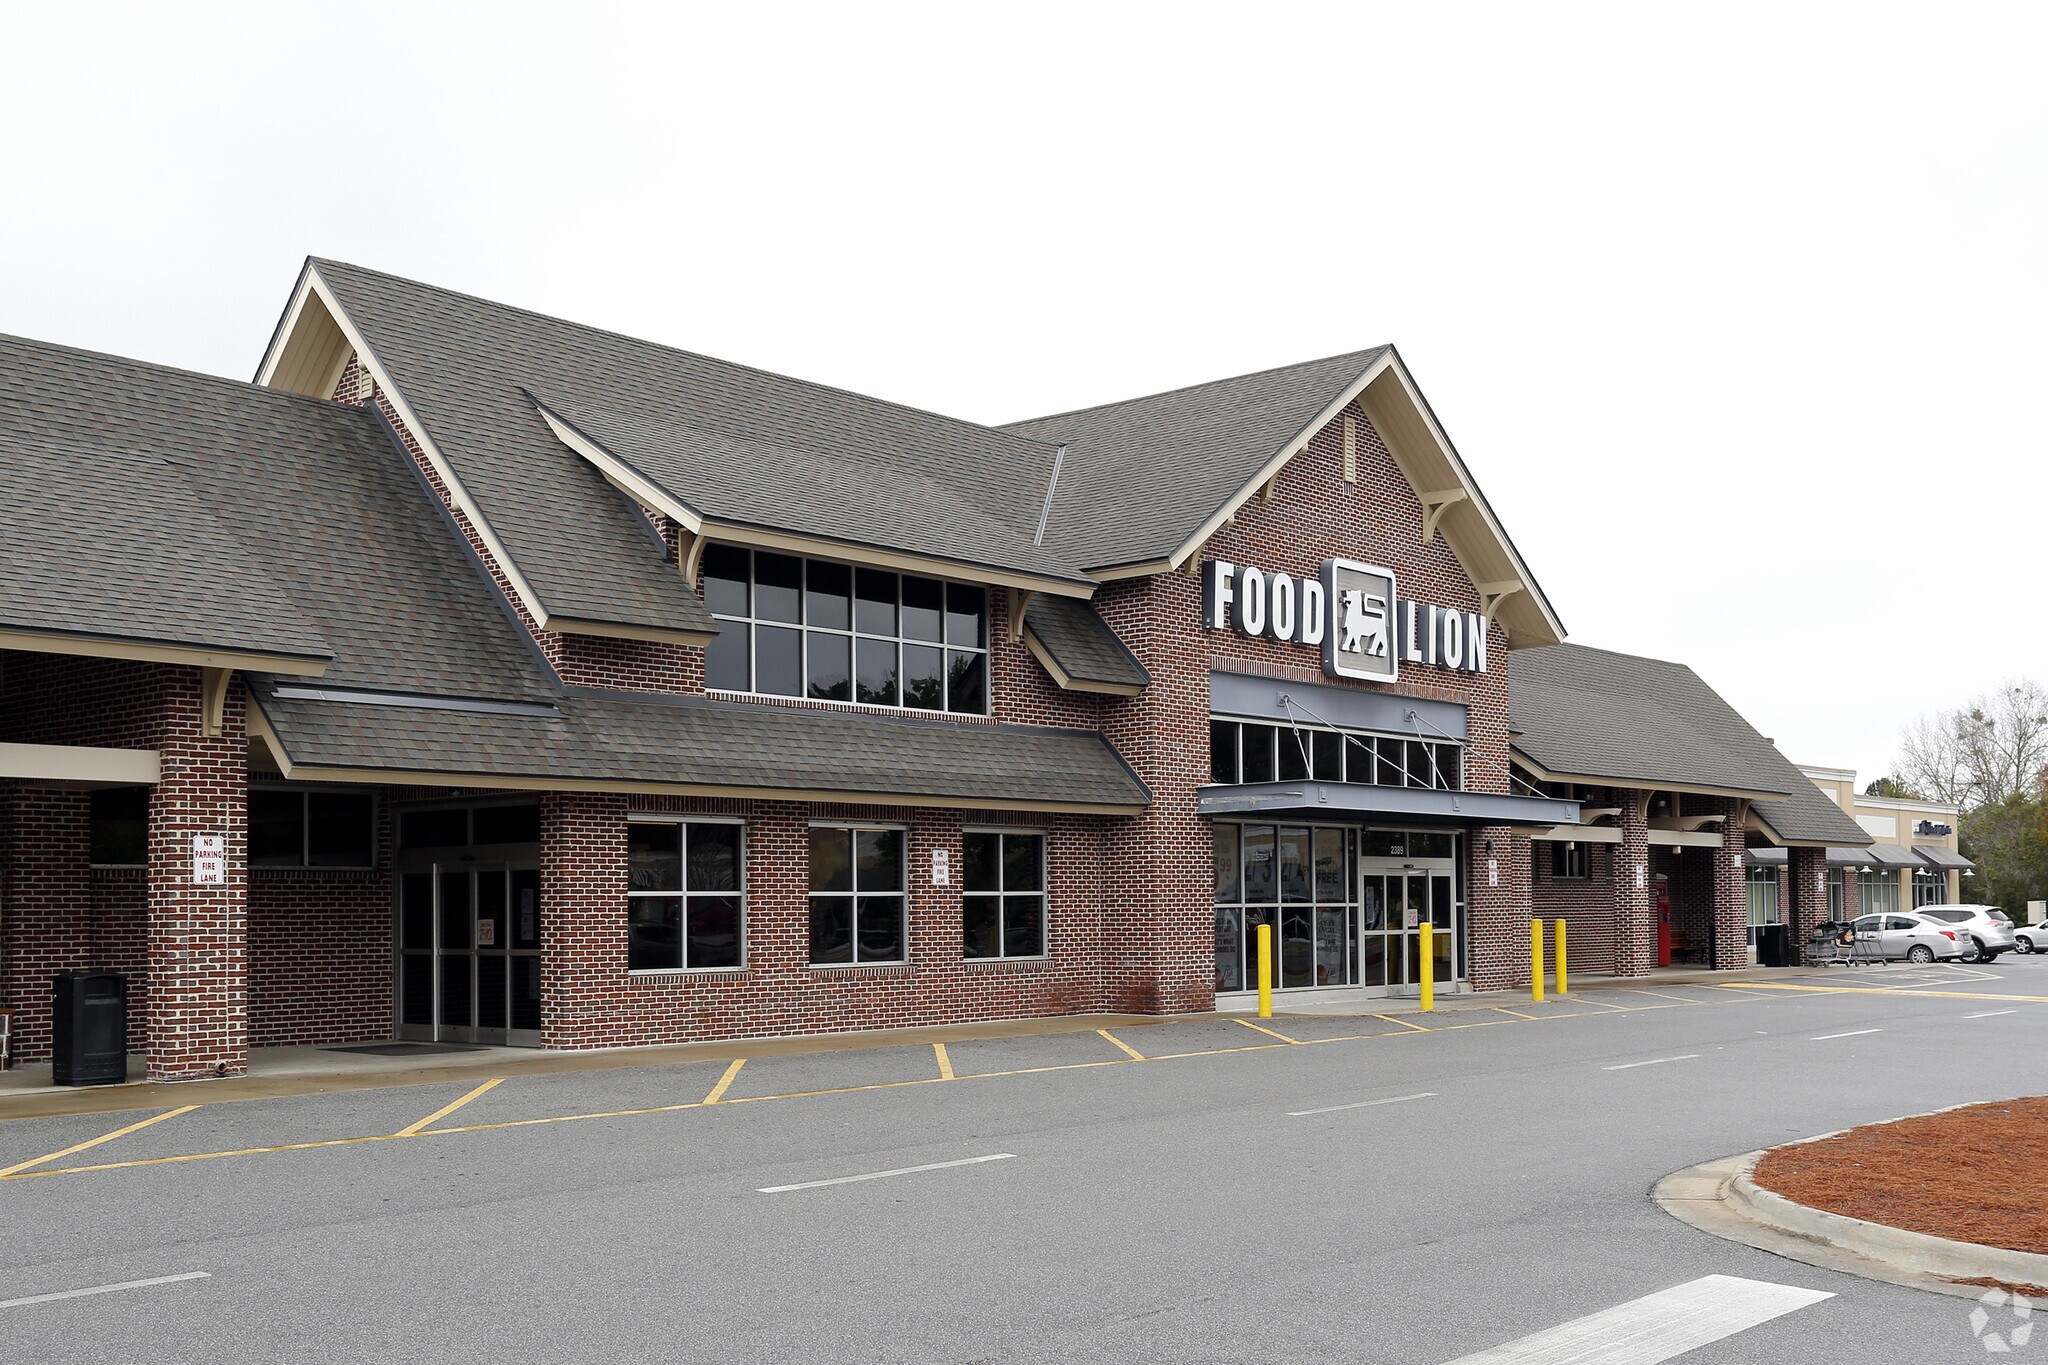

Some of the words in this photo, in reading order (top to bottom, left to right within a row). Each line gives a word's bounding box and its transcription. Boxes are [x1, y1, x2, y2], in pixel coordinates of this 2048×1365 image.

[1213, 560, 1325, 645] FOOD
[1405, 600, 1487, 673] LION
[203, 838, 214, 847] NO
[194, 850, 222, 859] PARKING
[202, 862, 216, 871] FIRE
[200, 874, 217, 883] LANE
[1317, 872, 1339, 884] FREE
